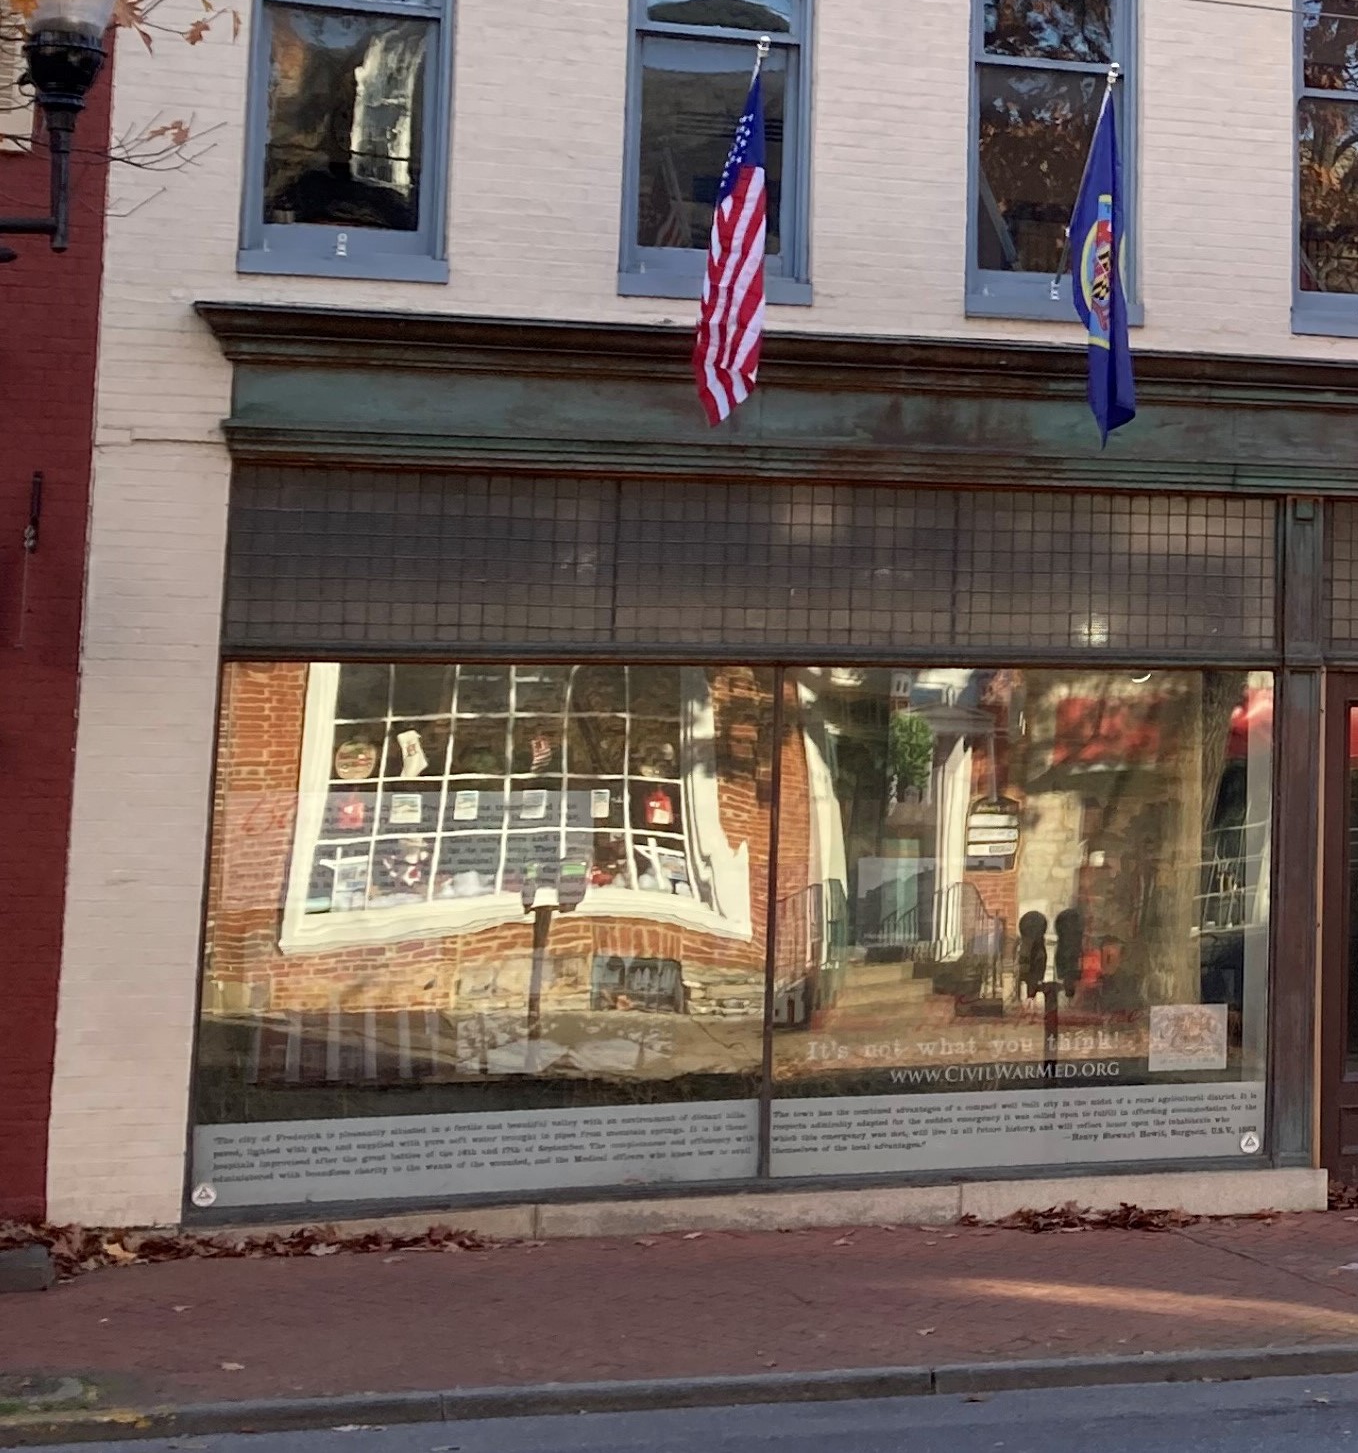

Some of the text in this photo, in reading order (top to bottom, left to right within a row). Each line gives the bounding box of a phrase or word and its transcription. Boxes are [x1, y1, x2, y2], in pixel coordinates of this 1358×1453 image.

[807, 1040, 849, 1060] It's
[864, 1038, 902, 1057] not
[917, 1034, 977, 1056] what
[992, 1037, 1033, 1059] you
